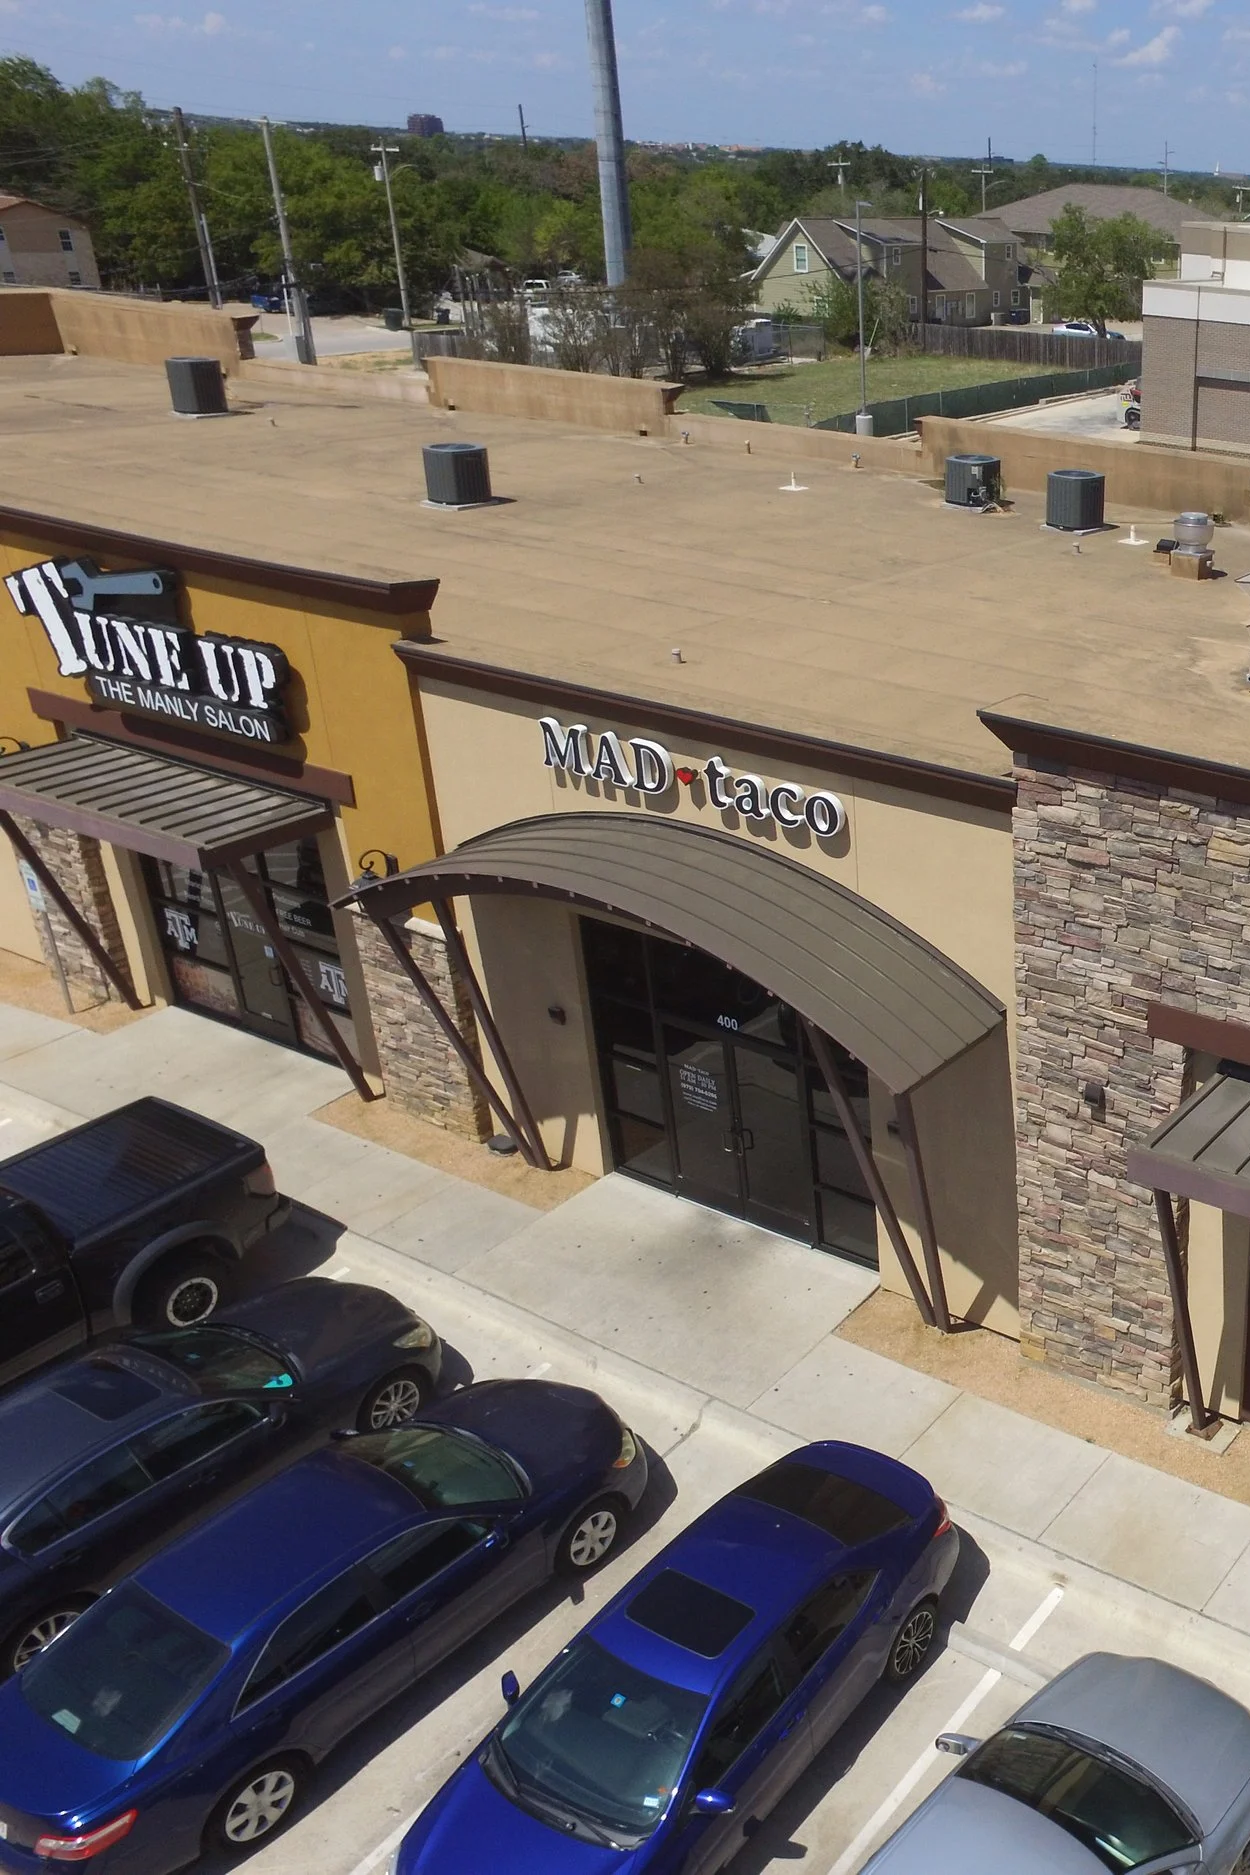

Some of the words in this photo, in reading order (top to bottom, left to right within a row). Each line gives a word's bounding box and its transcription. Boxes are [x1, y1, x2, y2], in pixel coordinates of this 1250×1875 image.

[3, 560, 190, 691] TUNE
[197, 639, 277, 710] UP
[95, 675, 136, 706] THE
[139, 687, 201, 723] MANLY
[204, 706, 272, 743] SALON
[538, 716, 675, 795] MAD
[702, 755, 846, 837] taco
[716, 1014, 738, 1031] 400
